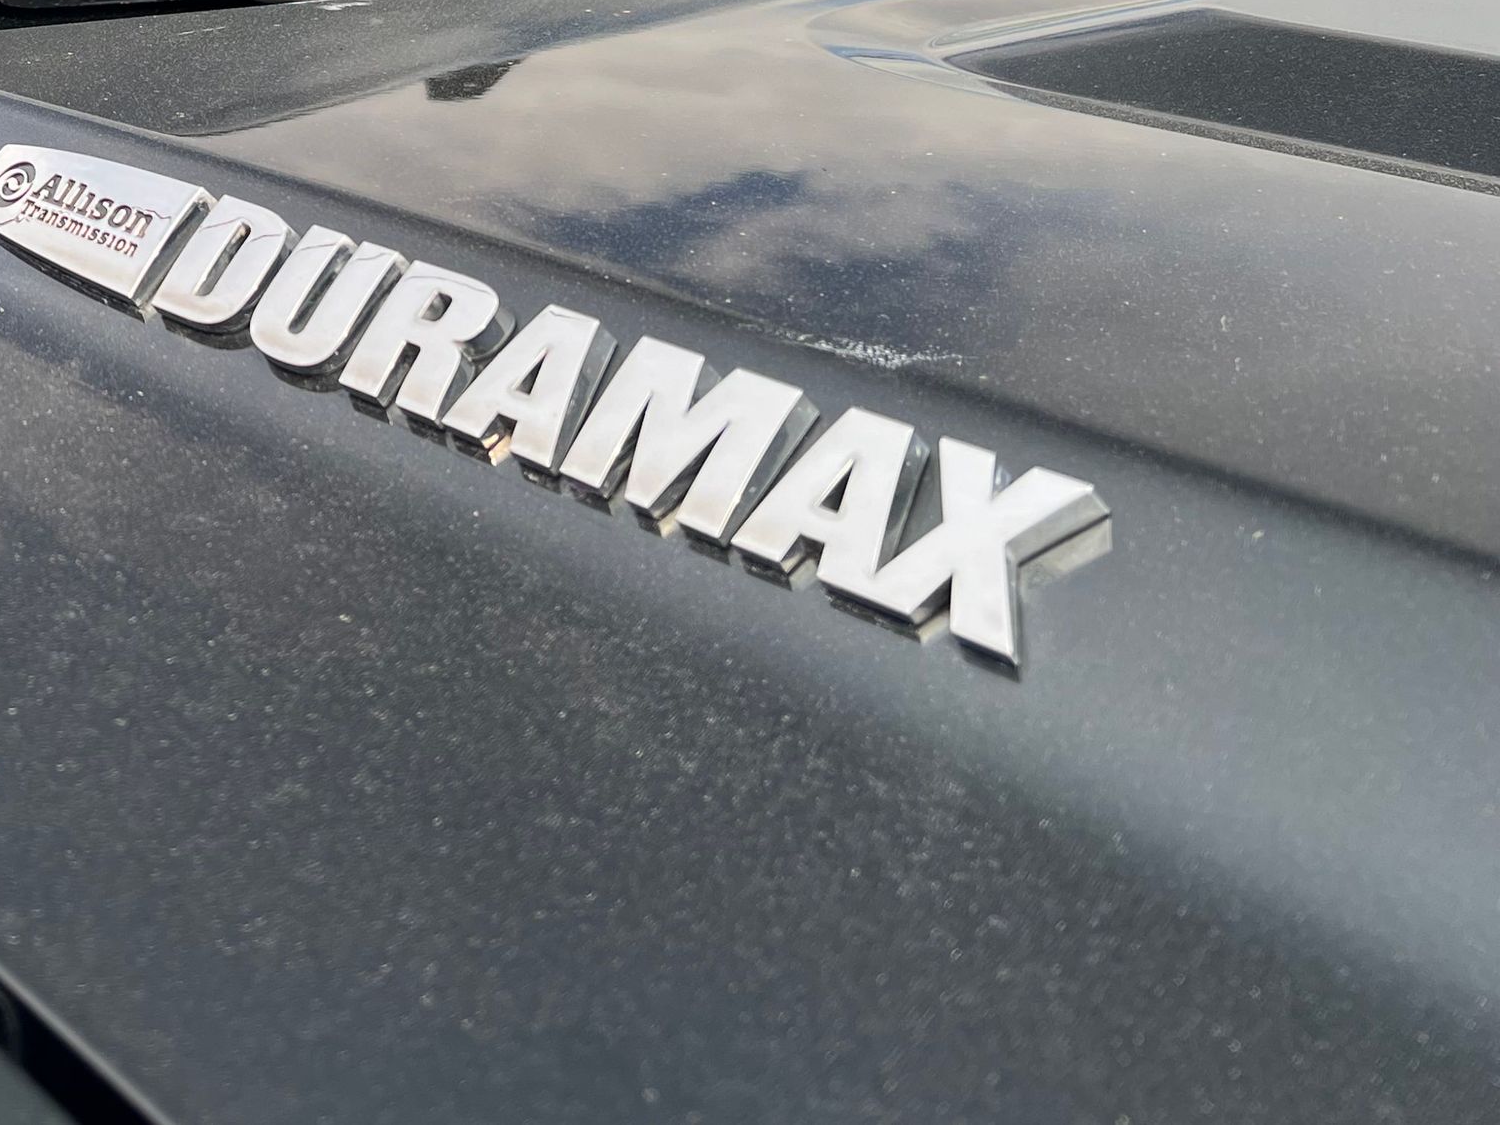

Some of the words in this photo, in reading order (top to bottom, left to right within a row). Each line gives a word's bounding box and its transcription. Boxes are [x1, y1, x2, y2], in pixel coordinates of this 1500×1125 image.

[20, 198, 138, 257] Transmission
[32, 174, 153, 238] Allison
[151, 194, 1111, 673] DURAMAX
